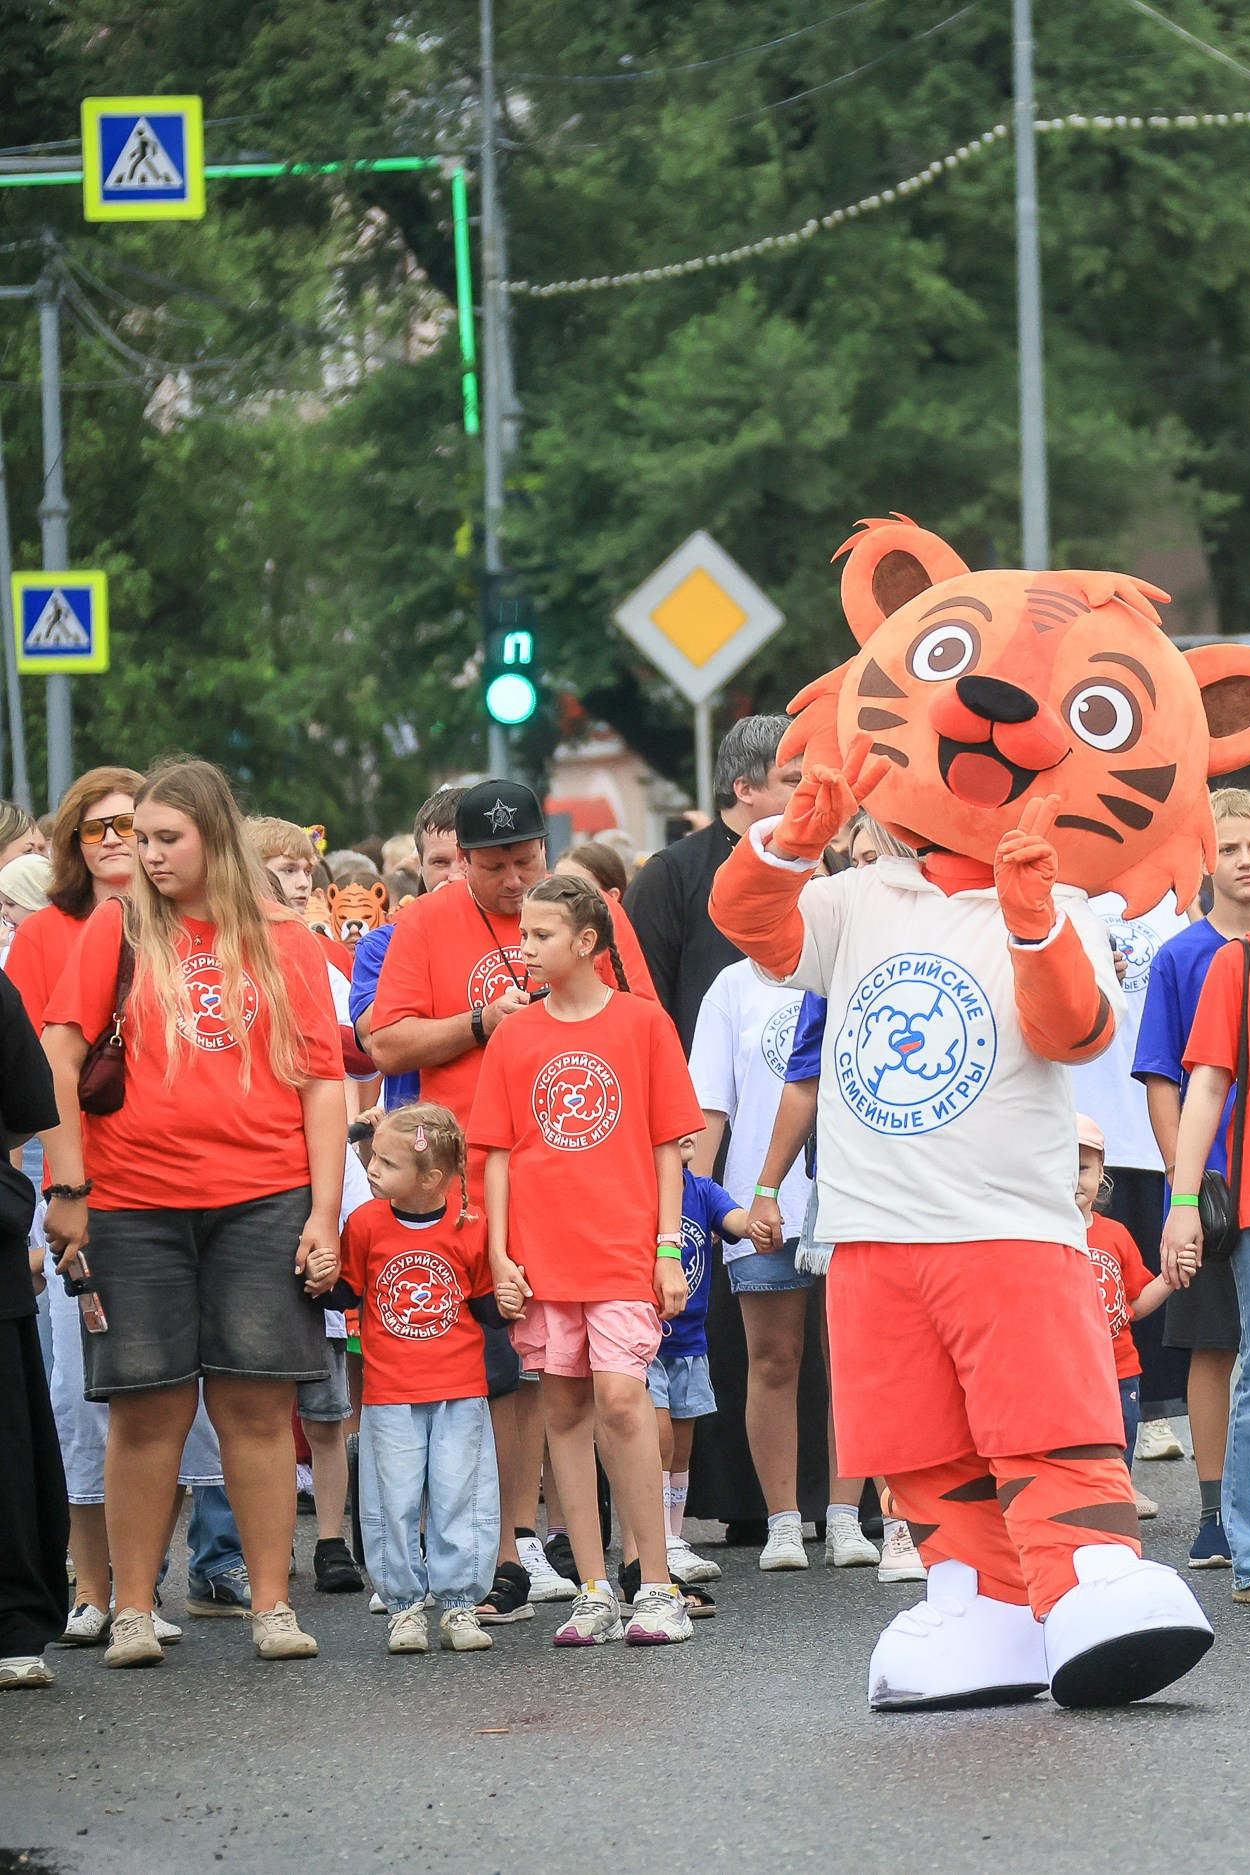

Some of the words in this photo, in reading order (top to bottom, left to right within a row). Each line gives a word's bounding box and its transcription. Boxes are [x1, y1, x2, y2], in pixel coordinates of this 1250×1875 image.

[853, 959, 984, 1021] УССУРИЙСКИЕ
[538, 1054, 614, 1090] УССУРИЙСКИЕ
[839, 1051, 924, 1129] СЕМЕЙНЫЕ
[931, 1061, 986, 1119] ИГРЫ
[591, 1108, 617, 1141] ИГРЫ
[381, 1254, 453, 1286] УССУРИЙСКИЕ
[380, 1302, 438, 1337] СЕМЕЙНЫЕ
